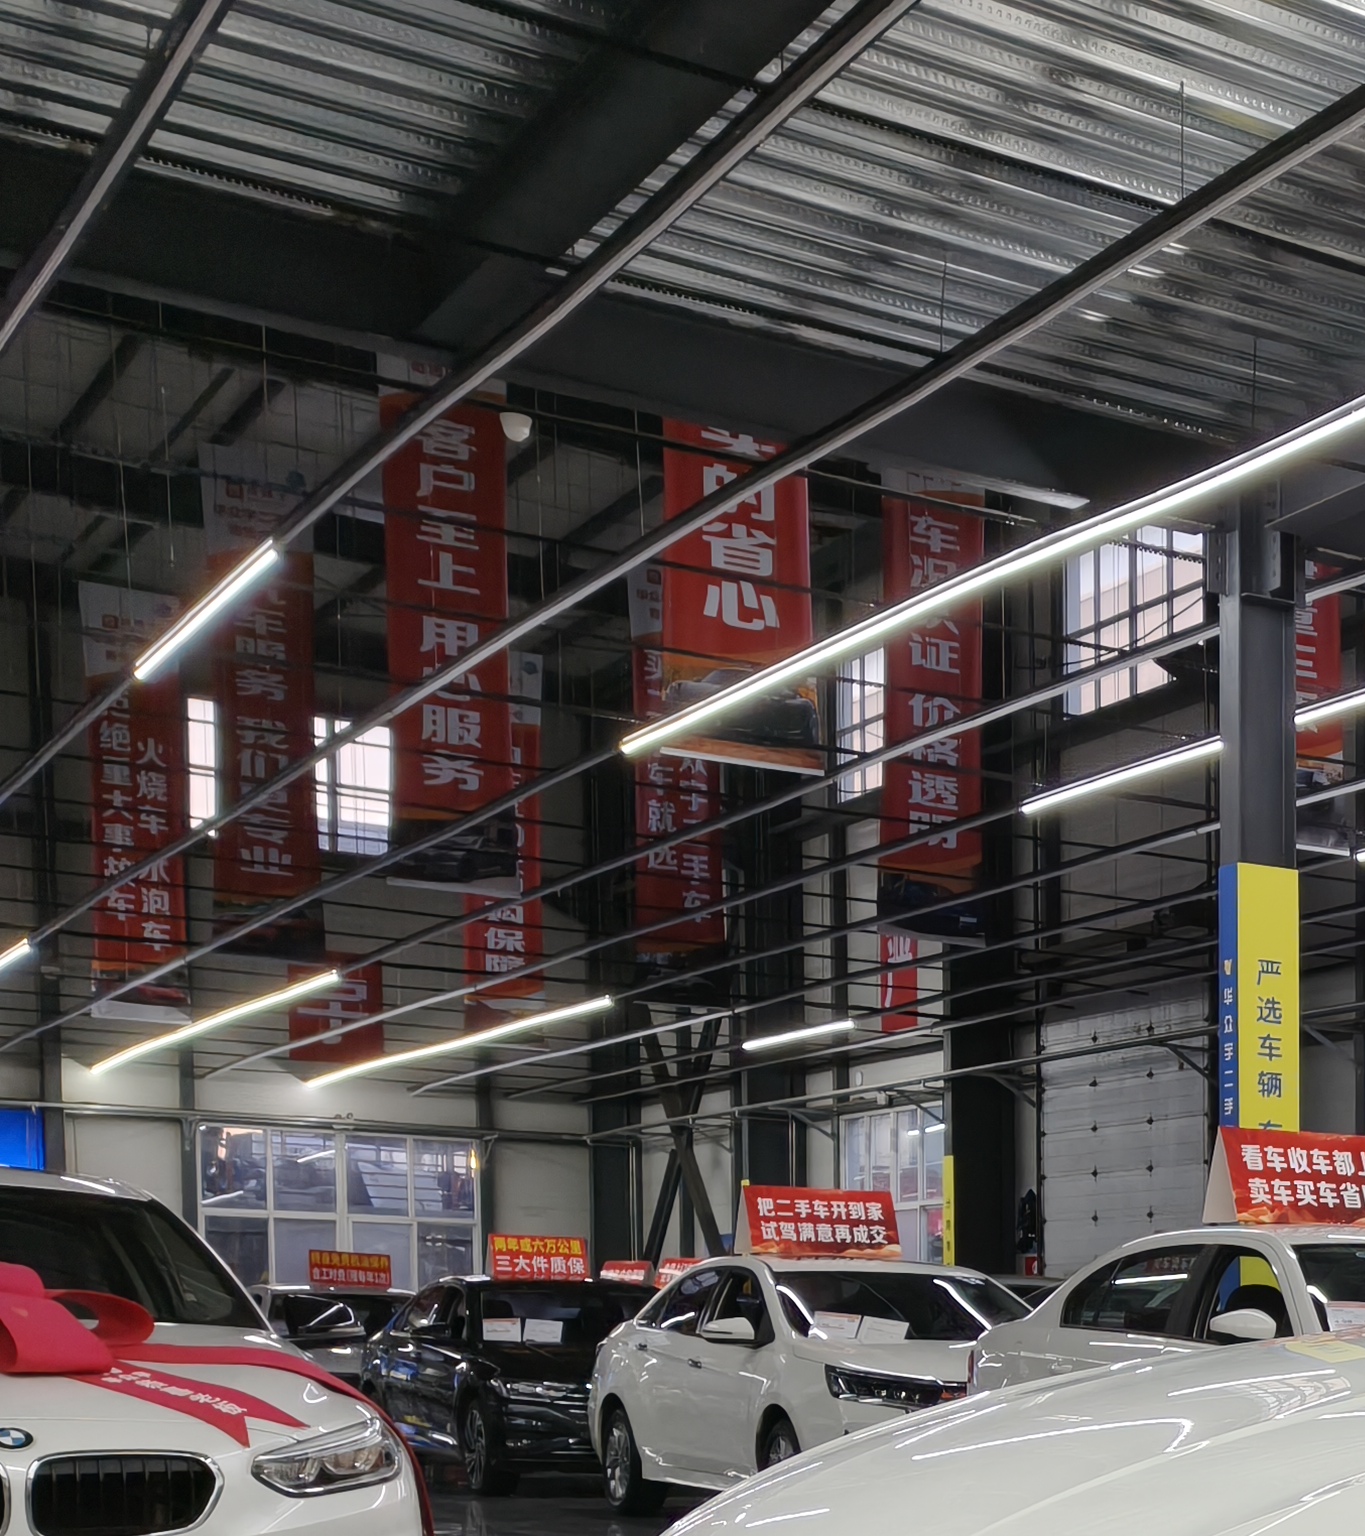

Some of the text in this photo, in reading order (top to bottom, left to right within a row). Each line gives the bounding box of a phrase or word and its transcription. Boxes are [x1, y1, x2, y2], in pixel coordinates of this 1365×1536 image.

[415, 418, 480, 594] 客户至上
[136, 736, 169, 835] 火烧车
[1222, 987, 1235, 1127] 华众宇二手
[1256, 958, 1283, 1098] 严选车辆
[757, 1197, 884, 1221] 把二手车开到家
[760, 1221, 888, 1245] 试驾满意再成交
[495, 1255, 586, 1275] 三大件质保
